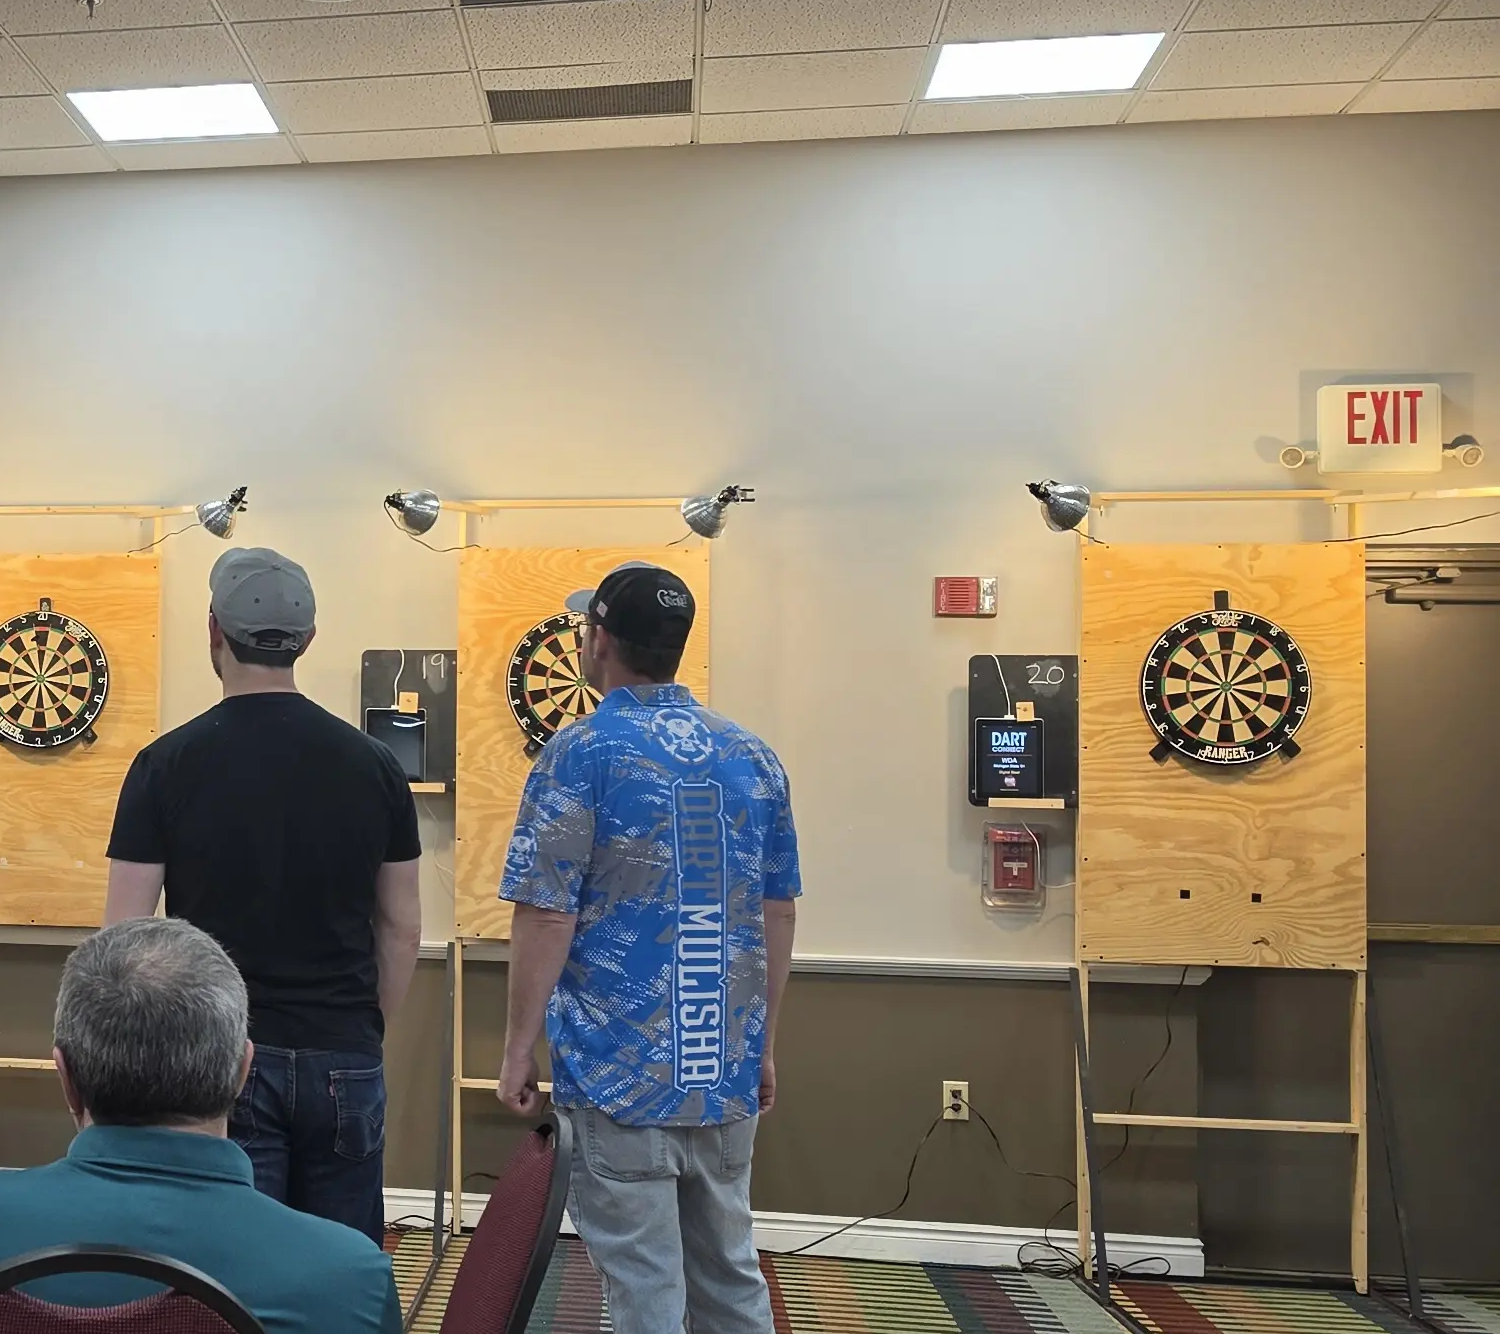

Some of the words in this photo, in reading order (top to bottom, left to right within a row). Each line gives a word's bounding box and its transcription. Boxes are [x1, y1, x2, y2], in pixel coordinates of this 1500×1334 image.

[1347, 390, 1423, 444] EXIT
[38, 613, 48, 621] 20
[1177, 624, 1189, 634] 12
[423, 653, 444, 679] 19
[1148, 657, 1159, 667] 14
[509, 677, 518, 686] 11
[1026, 663, 1064, 685] 20
[1144, 680, 1154, 689] 11
[991, 731, 1027, 746] DART
[1204, 745, 1248, 760] RANGER
[678, 788, 721, 900] DART
[678, 902, 722, 1083] MULISHA
